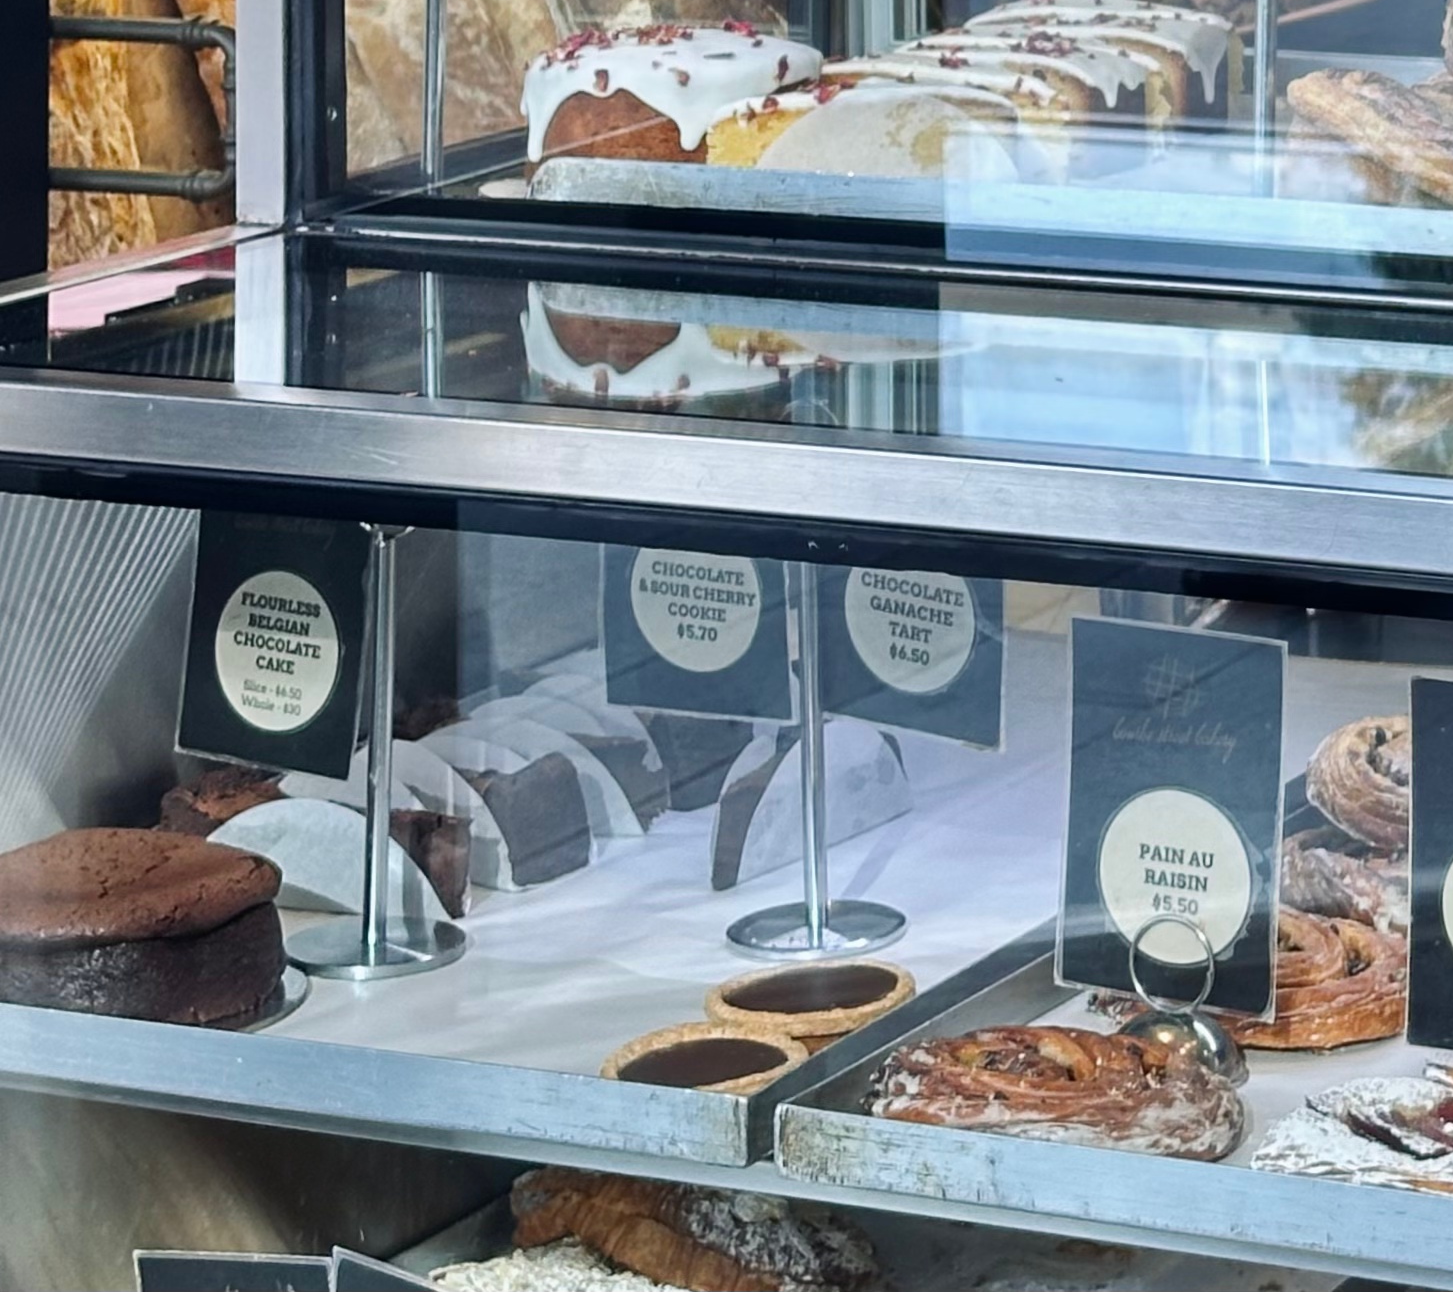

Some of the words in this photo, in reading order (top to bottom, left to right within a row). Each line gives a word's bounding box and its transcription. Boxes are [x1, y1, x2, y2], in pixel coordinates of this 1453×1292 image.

[651, 560, 745, 586] CHOCOLATE
[638, 578, 649, 593] &
[649, 580, 691, 599] SOUR
[692, 585, 757, 607] CHERRY
[861, 572, 965, 608] CHOCOLATE
[241, 592, 321, 618] FLOURLESS
[668, 602, 726, 623] COOKIE
[869, 595, 955, 628] GANACHE
[248, 613, 310, 636] BELGIAN
[676, 623, 718, 642] $5.70
[888, 621, 932, 644] TART
[234, 630, 321, 659] CHOCOLATE
[889, 642, 931, 666] $6.50
[256, 656, 295, 675] CAKE
[1138, 843, 1185, 865] PAIN
[1188, 849, 1214, 869] AU
[1143, 868, 1208, 893] RAISIN
[1151, 895, 1199, 915] $5.50
